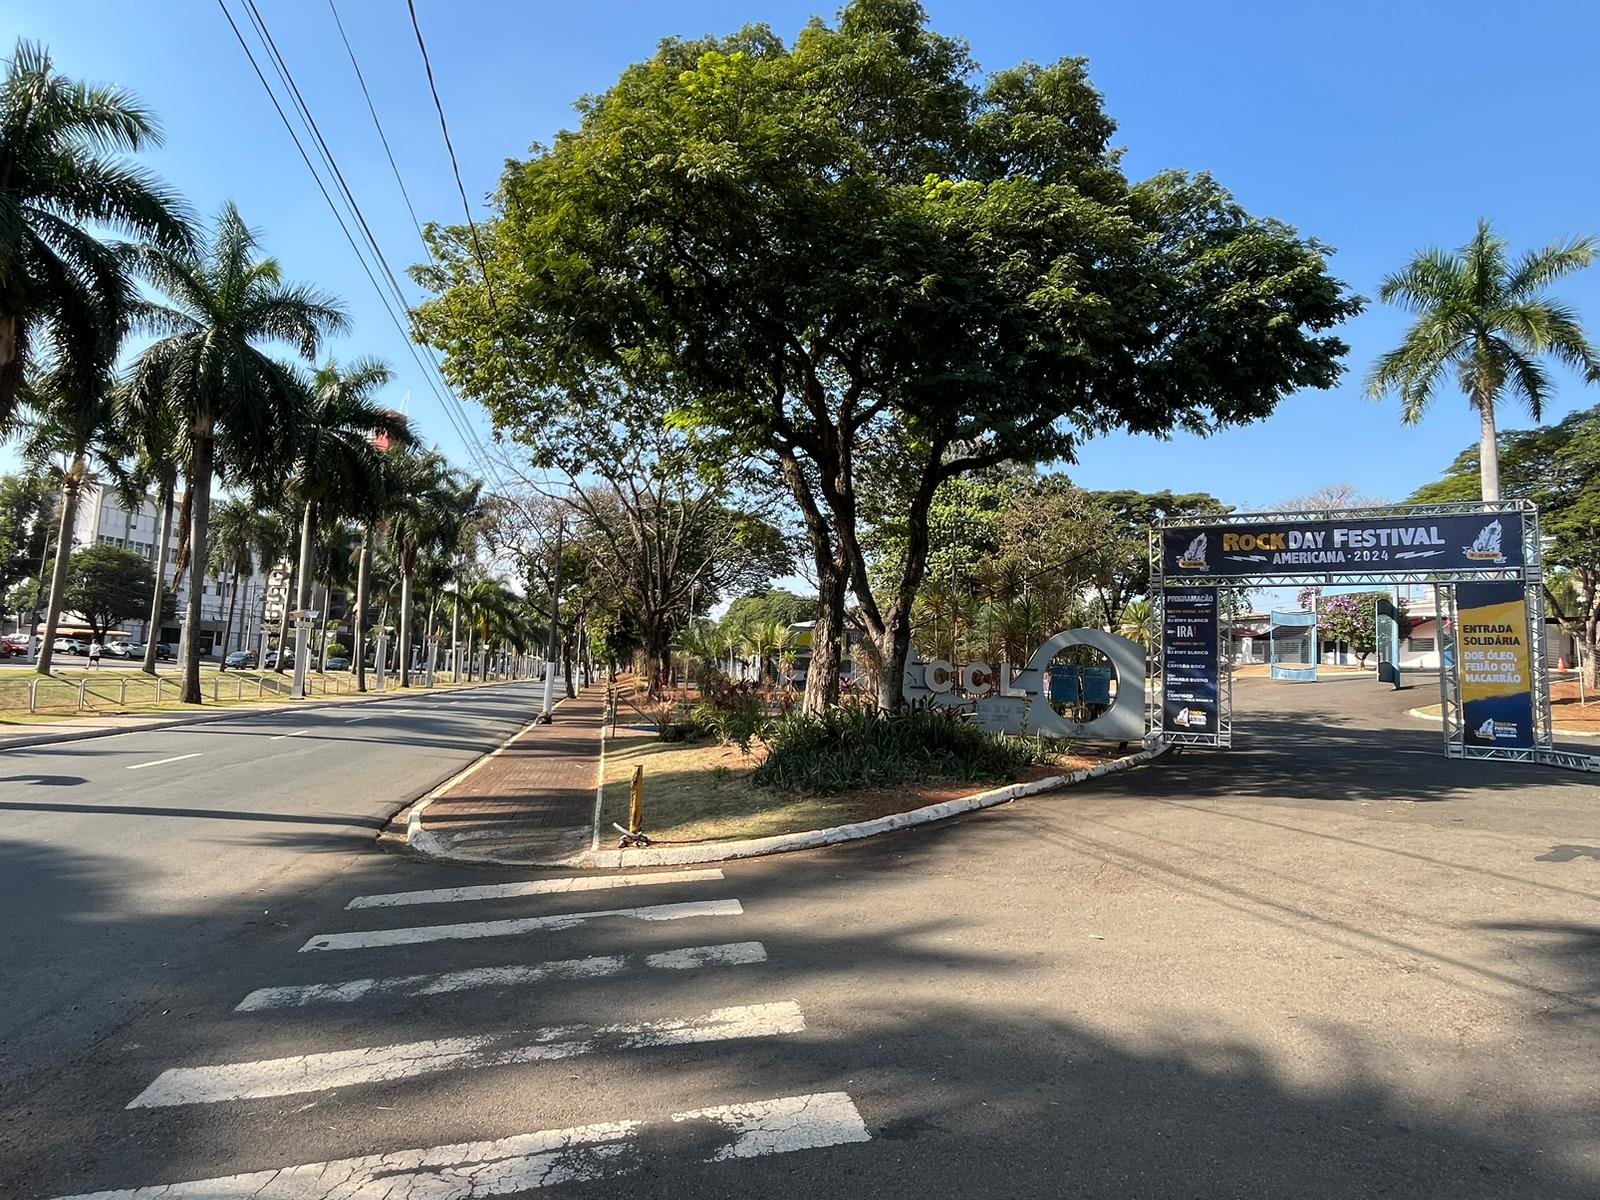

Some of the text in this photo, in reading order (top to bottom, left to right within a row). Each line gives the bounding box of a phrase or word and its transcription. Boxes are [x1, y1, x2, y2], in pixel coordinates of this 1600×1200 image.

[1223, 526, 1445, 551] ROCK DAY FESTIVAL
[1272, 550, 1389, 565] AMERICANA 2024
[1464, 625, 1513, 633] ENTRADA
[1463, 635, 1521, 646] SOLIDÁRIA
[1464, 650, 1518, 663] DOE ÓLEO,
[1465, 662, 1515, 672] FEIJÃO OU
[1466, 673, 1521, 683] MACARRÃO
